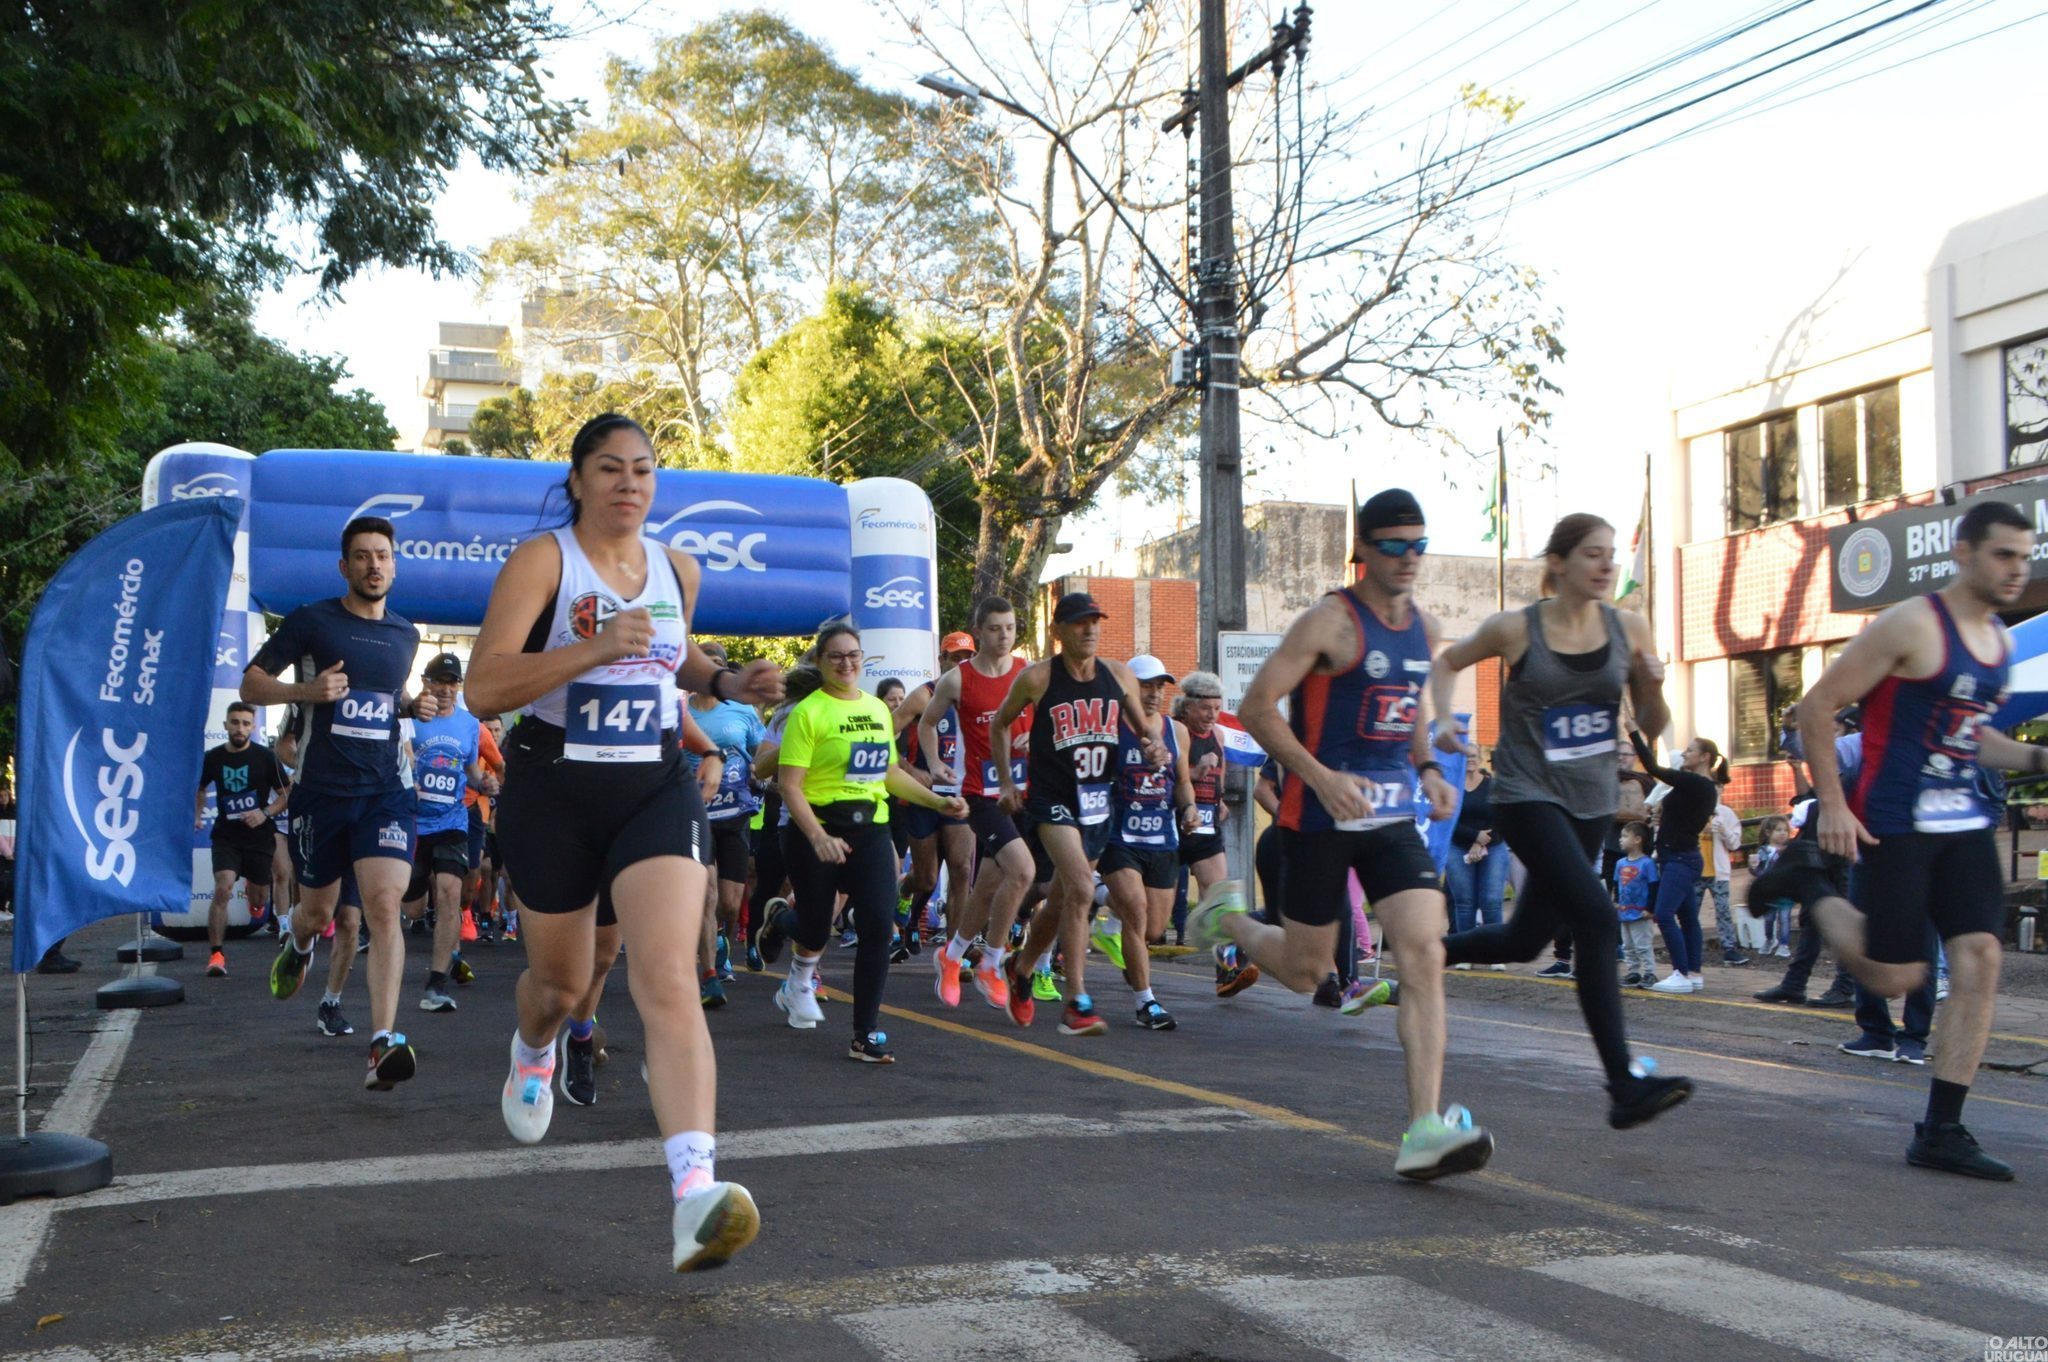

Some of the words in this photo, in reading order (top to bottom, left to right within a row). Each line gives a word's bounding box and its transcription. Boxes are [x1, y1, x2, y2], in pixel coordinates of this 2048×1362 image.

[861, 520, 917, 530] Fecomércio
[919, 523, 928, 532] RS
[864, 586, 925, 609] Sesc
[100, 558, 144, 702] Fecomércio
[1226, 646, 1278, 658] ESTACIONAMENT
[133, 629, 164, 705] Senac
[865, 668, 921, 678] Fecomércio
[341, 699, 390, 722] 044
[580, 698, 656, 732] 147
[1550, 710, 1611, 739] 185
[853, 749, 889, 768] 012
[1074, 745, 1108, 779] 30
[424, 773, 456, 791] 069
[85, 727, 148, 888] Sesc
[228, 797, 255, 810] 110
[1080, 791, 1108, 810] 056
[1127, 815, 1163, 832] 059
